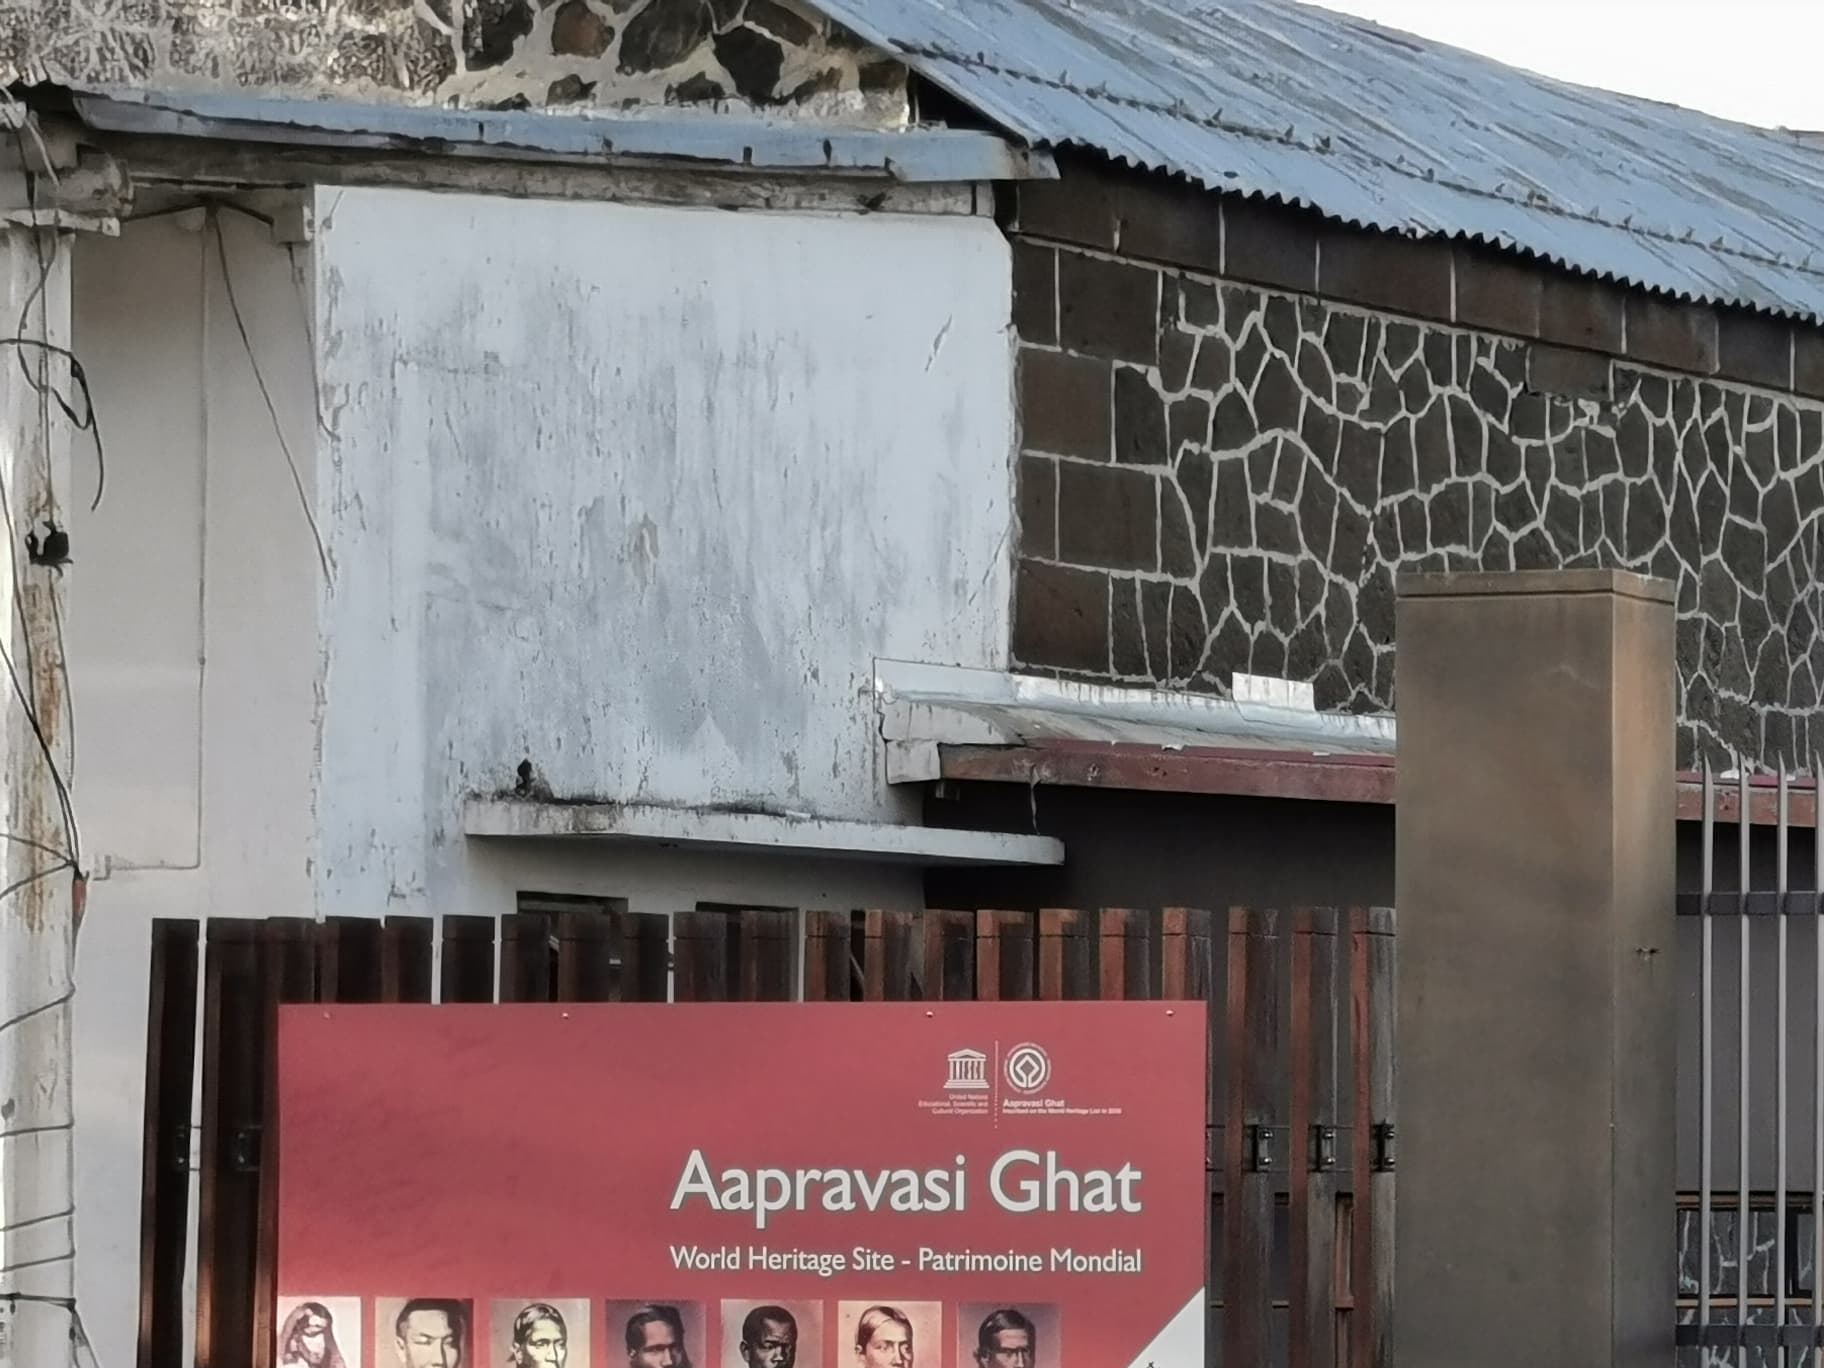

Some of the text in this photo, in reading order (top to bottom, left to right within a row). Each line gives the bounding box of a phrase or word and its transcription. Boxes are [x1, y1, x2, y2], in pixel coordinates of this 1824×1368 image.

[670, 1149, 1142, 1229] Aapravasi Ghat
[670, 1246, 740, 1272] World
[748, 1246, 845, 1276] Heritage
[852, 1247, 895, 1272] Site
[919, 1248, 1042, 1273] Patrimoine
[1050, 1247, 1142, 1273] Mondial
